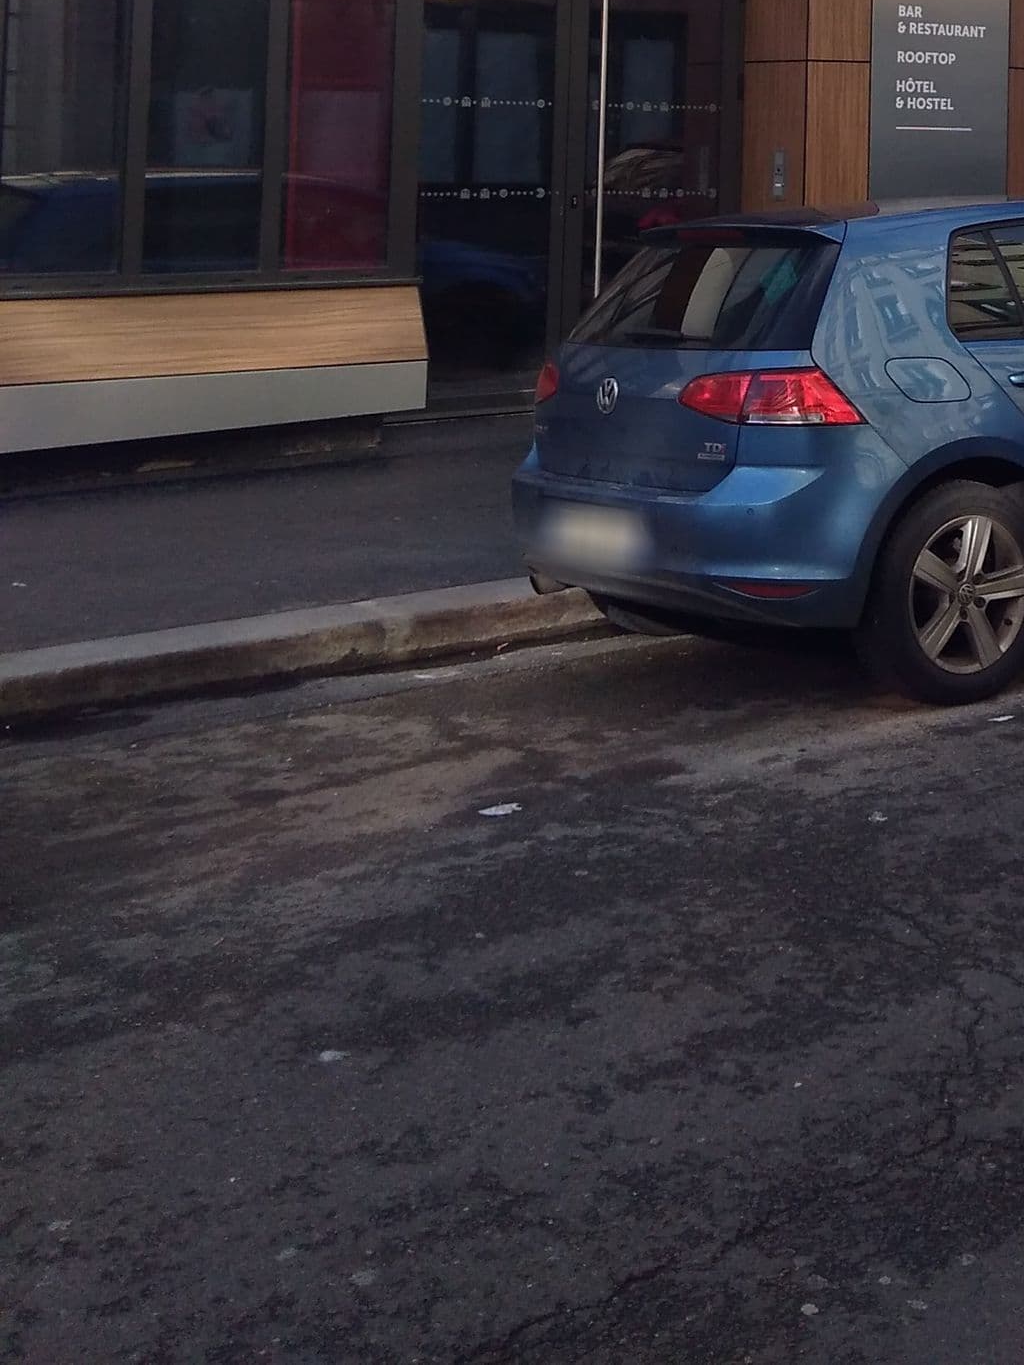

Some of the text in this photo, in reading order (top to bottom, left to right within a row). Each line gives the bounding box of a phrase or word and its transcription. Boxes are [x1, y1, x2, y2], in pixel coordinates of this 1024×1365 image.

[898, 5, 922, 18] BAR
[897, 21, 986, 38] & RESTAURANT
[897, 50, 956, 65] ROOFTOP
[896, 77, 936, 93] HÔTEL
[895, 96, 954, 111] & HOSTEL
